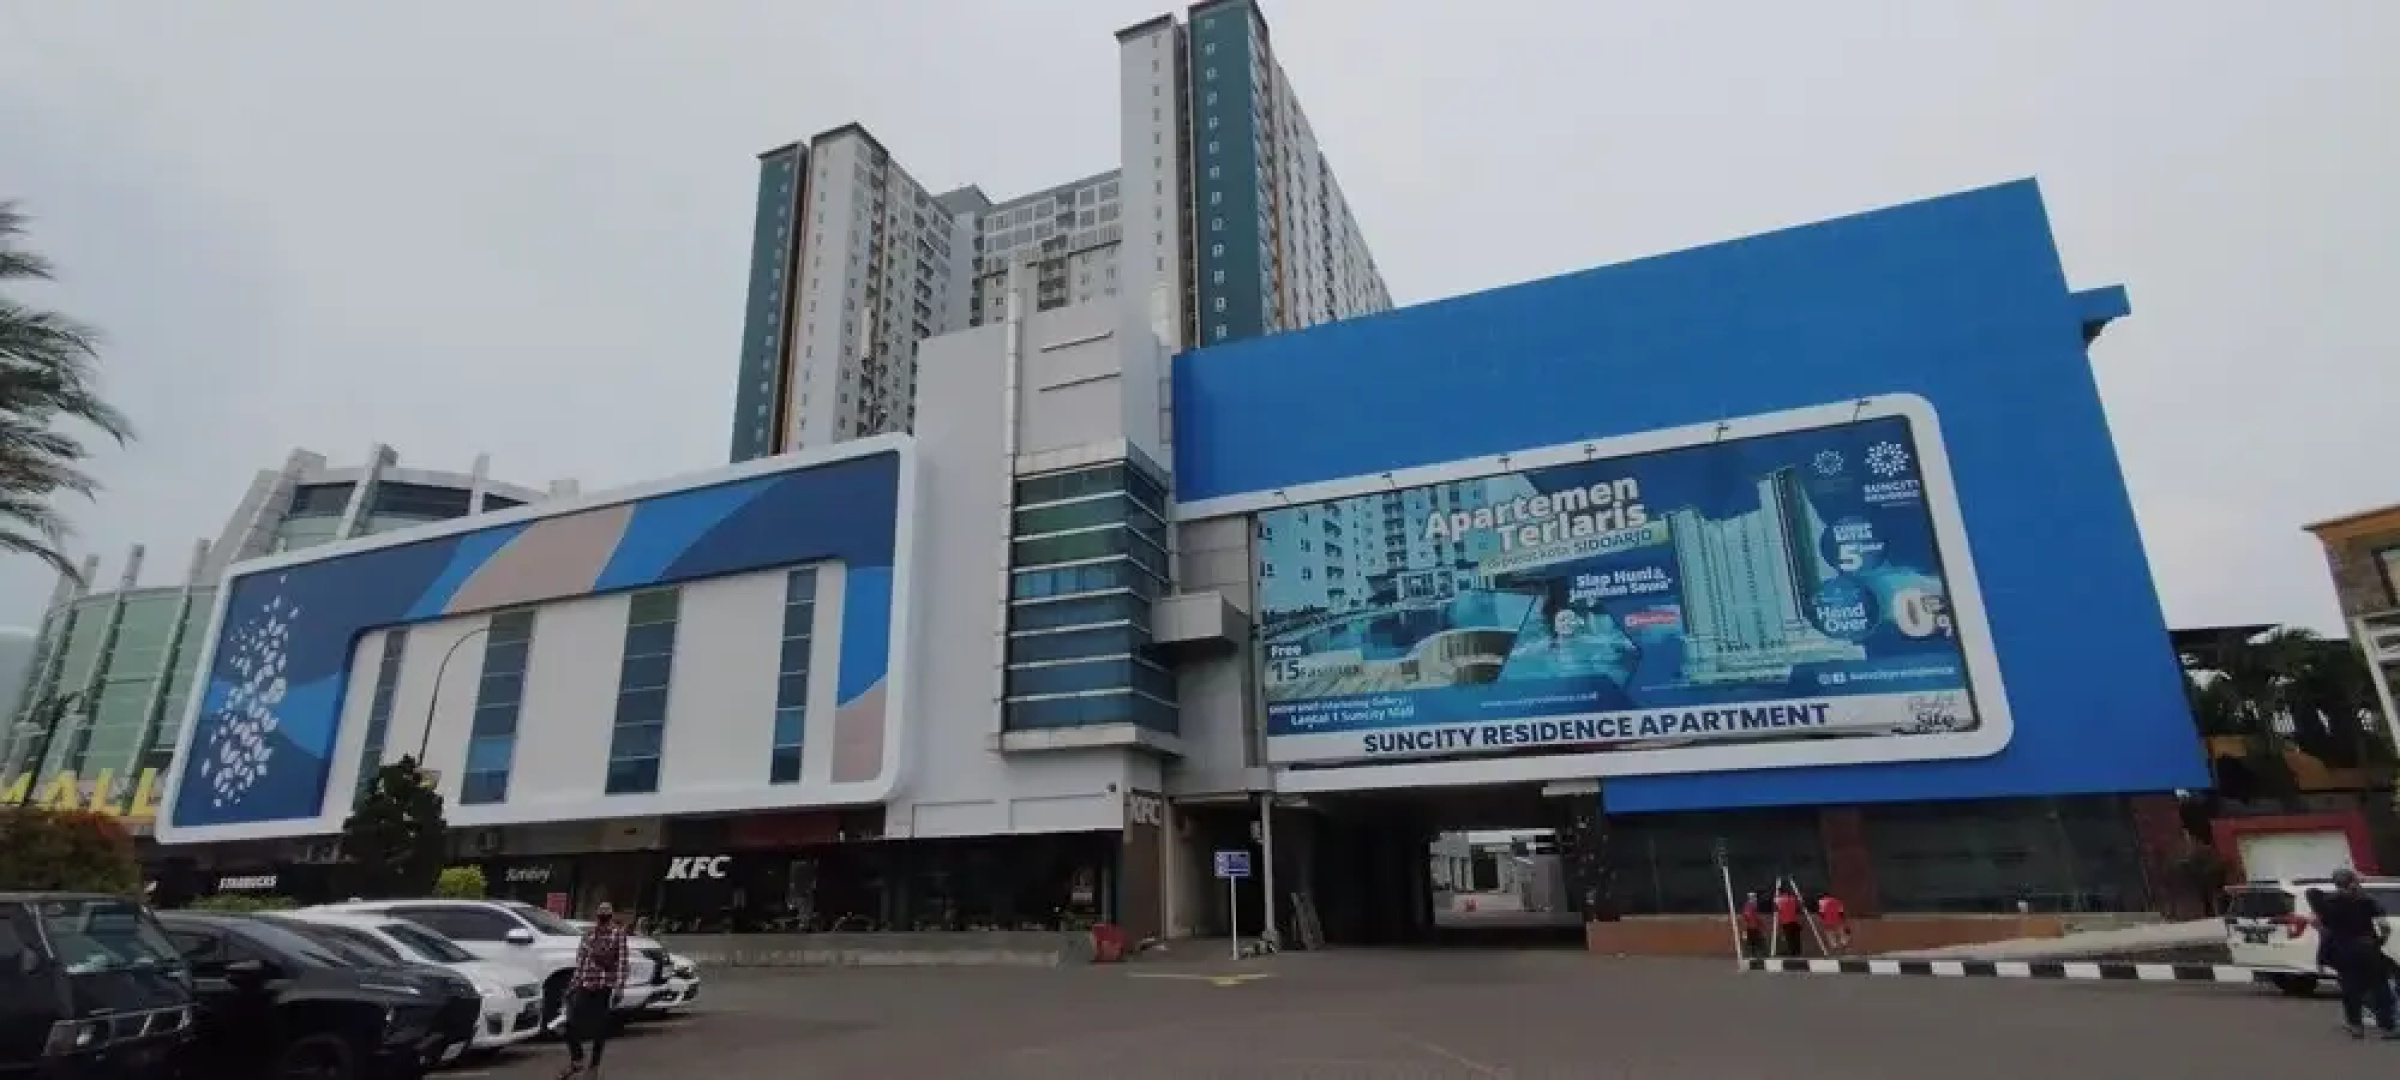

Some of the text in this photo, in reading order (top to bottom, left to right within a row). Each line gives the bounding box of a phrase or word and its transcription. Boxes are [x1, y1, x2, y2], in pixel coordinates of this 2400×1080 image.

[1426, 477, 1639, 542] Apartemen
[1497, 499, 1648, 550] Terlaris
[1816, 602, 1866, 619] Hand
[1824, 617, 1868, 632] Over
[1272, 660, 1299, 682] 15
[1363, 703, 1830, 752] SUNCITY RESIDENCE APARTMENT
[665, 856, 731, 880] KFC
